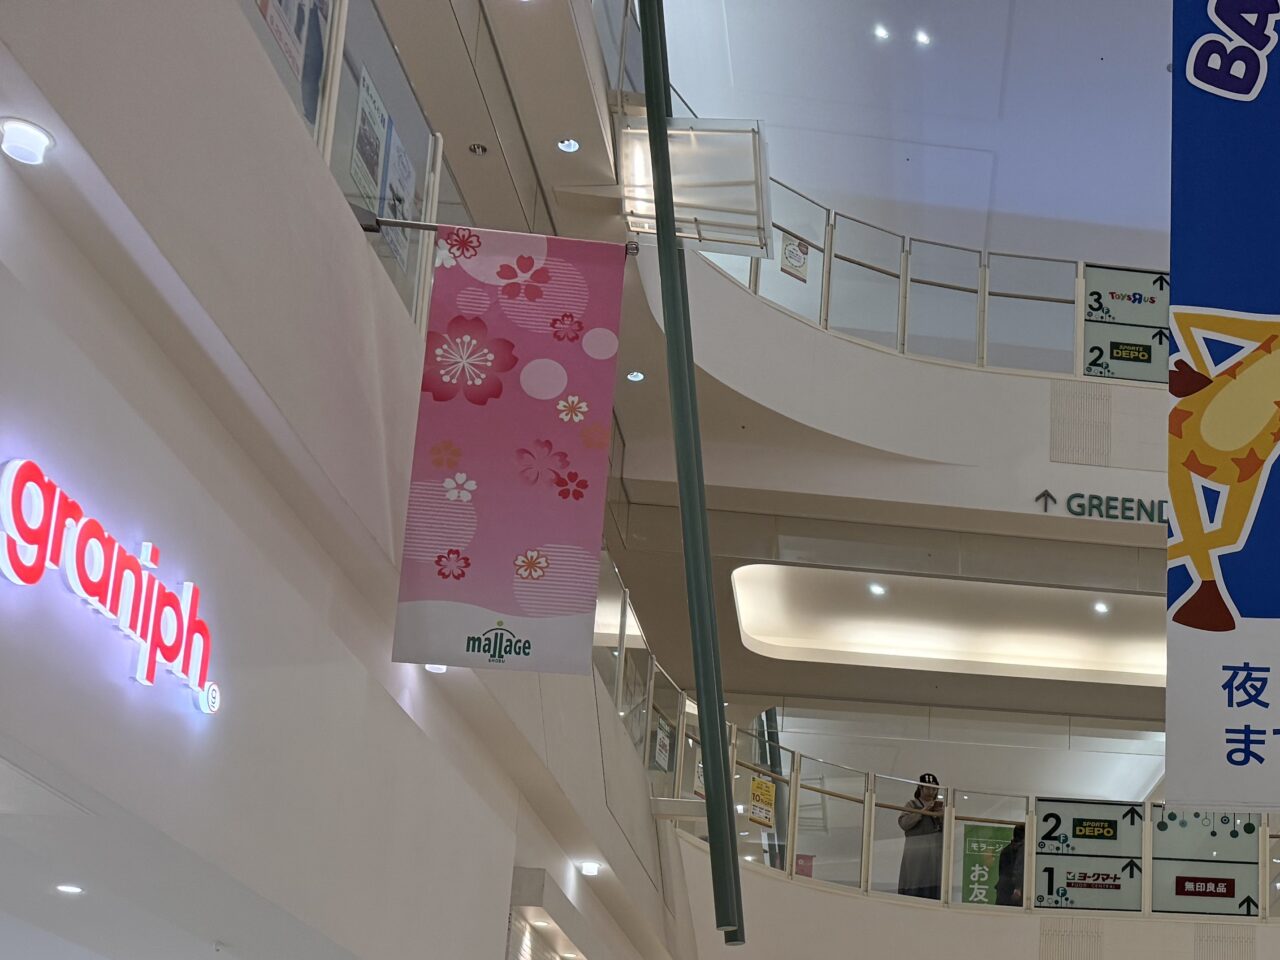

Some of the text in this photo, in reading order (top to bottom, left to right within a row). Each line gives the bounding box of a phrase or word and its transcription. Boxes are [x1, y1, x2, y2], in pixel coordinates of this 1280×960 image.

[1113, 349, 1149, 360] DEPO
[0, 459, 212, 692] graniph
[1075, 826, 1114, 837] DEPO
[1077, 871, 1121, 883] ヨークマート
[1184, 881, 1227, 893] 無印良品
